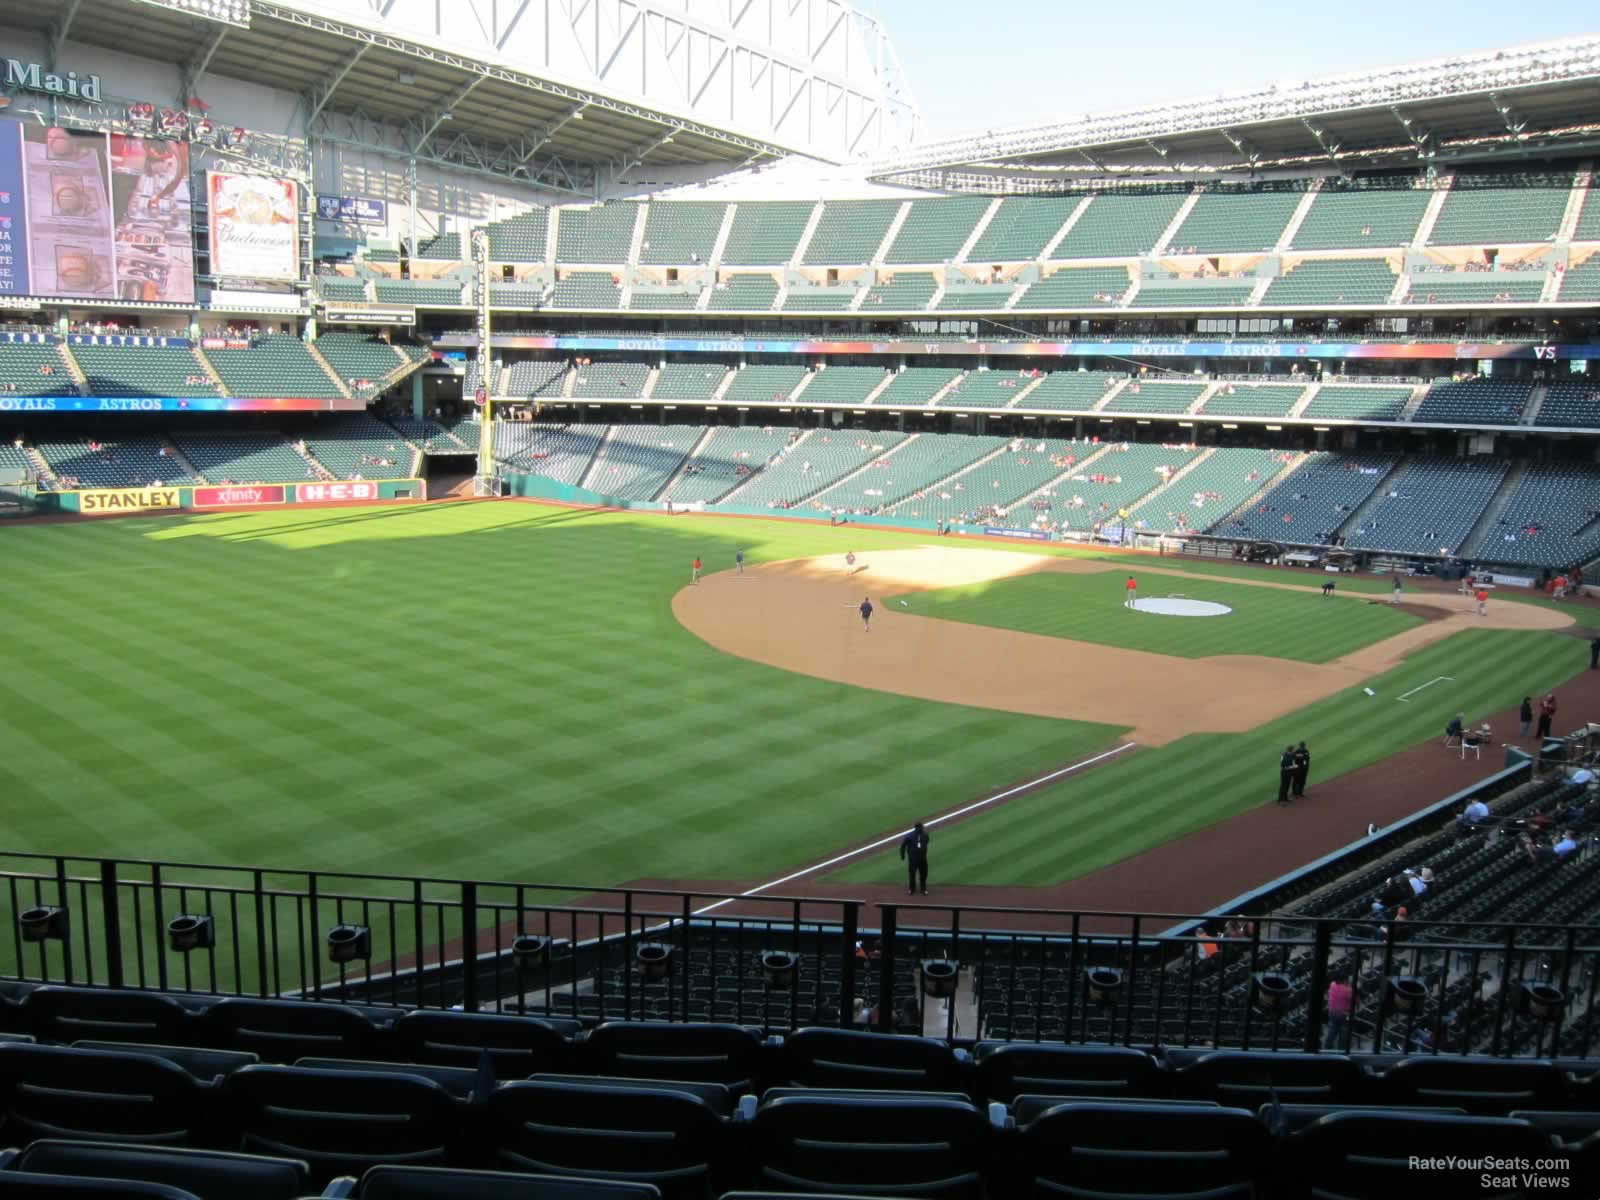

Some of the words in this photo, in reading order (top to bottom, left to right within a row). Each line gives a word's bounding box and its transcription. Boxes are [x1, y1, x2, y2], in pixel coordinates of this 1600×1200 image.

[7, 59, 103, 105] Maid
[618, 340, 665, 350] ROYALS
[697, 341, 745, 352] ASTROS
[1132, 344, 1186, 356] ROYALS
[1224, 344, 1281, 356] ASTROS
[1534, 346, 1556, 359] VS
[100, 398, 162, 411] ASTROS
[84, 491, 175, 509] STANLEY
[217, 486, 262, 503] xfinity
